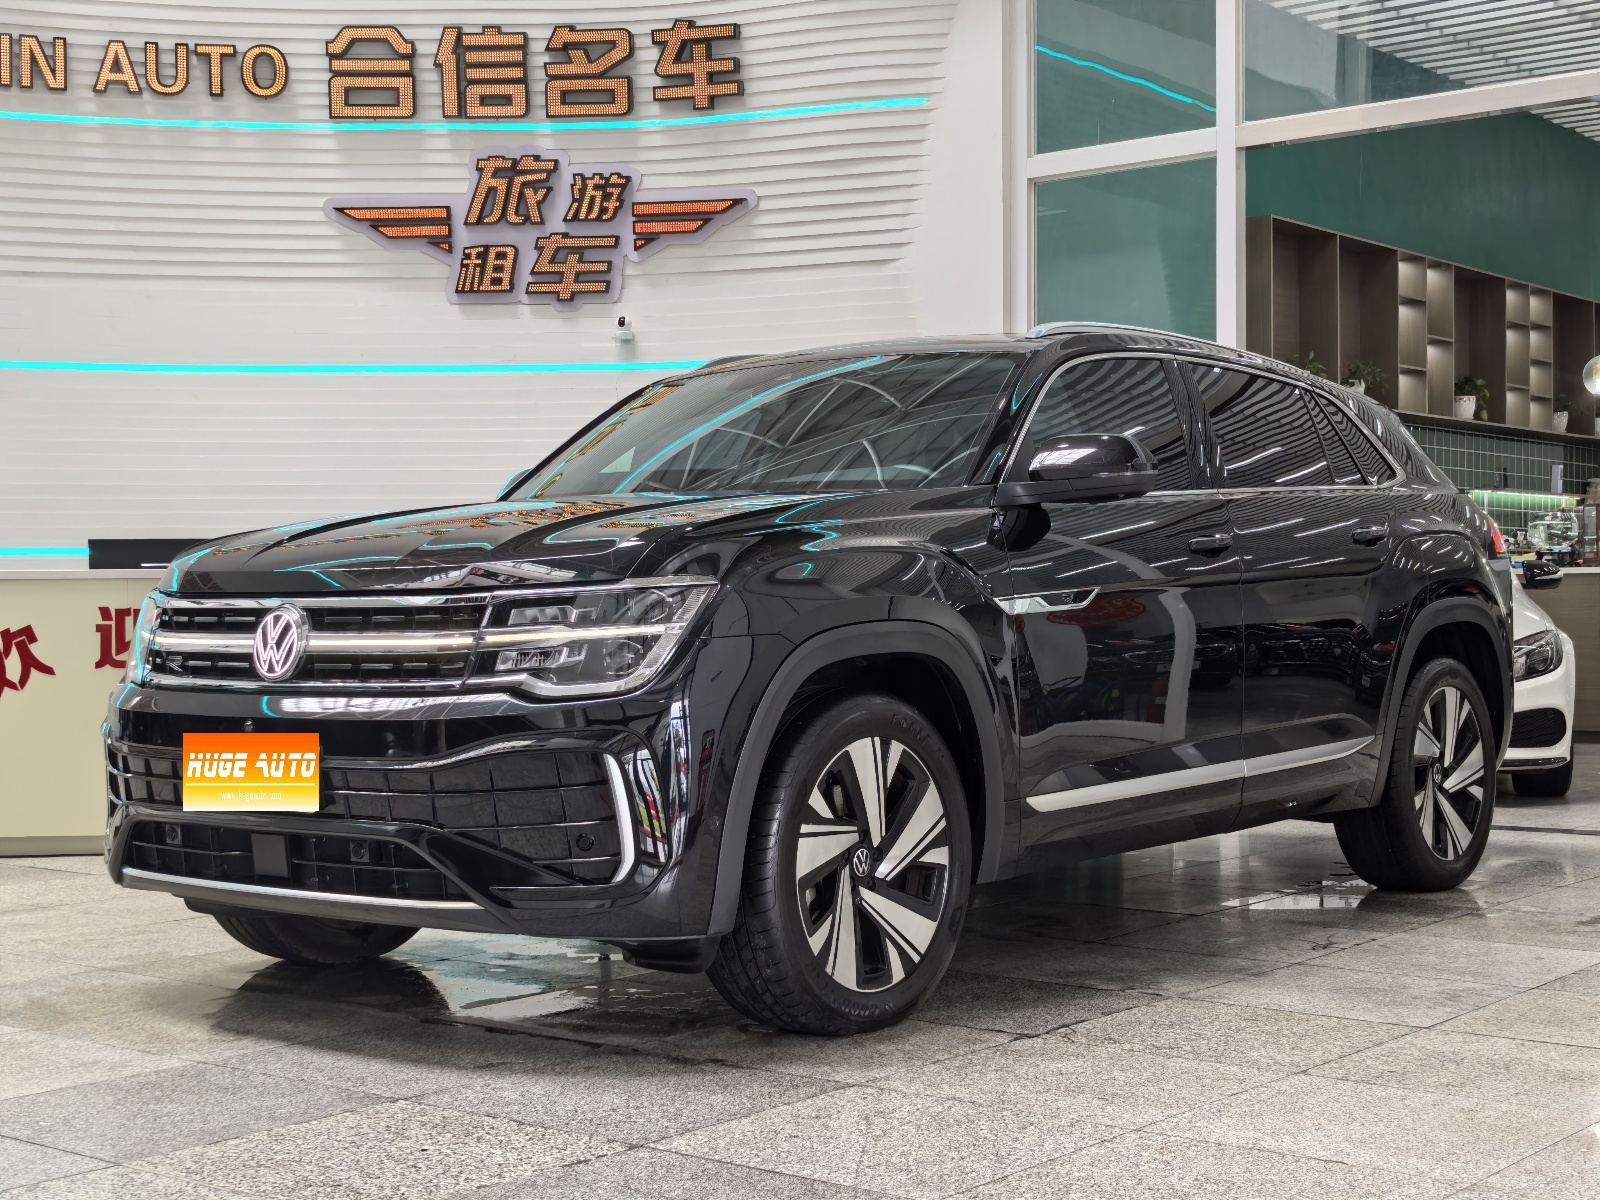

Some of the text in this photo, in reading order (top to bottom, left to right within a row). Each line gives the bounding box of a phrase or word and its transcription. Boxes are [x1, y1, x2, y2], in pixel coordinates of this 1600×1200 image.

[0, 33, 289, 99] IN AUTO
[326, 19, 743, 119] 合信名车
[463, 155, 631, 226] 旅游
[455, 232, 620, 302] 租车
